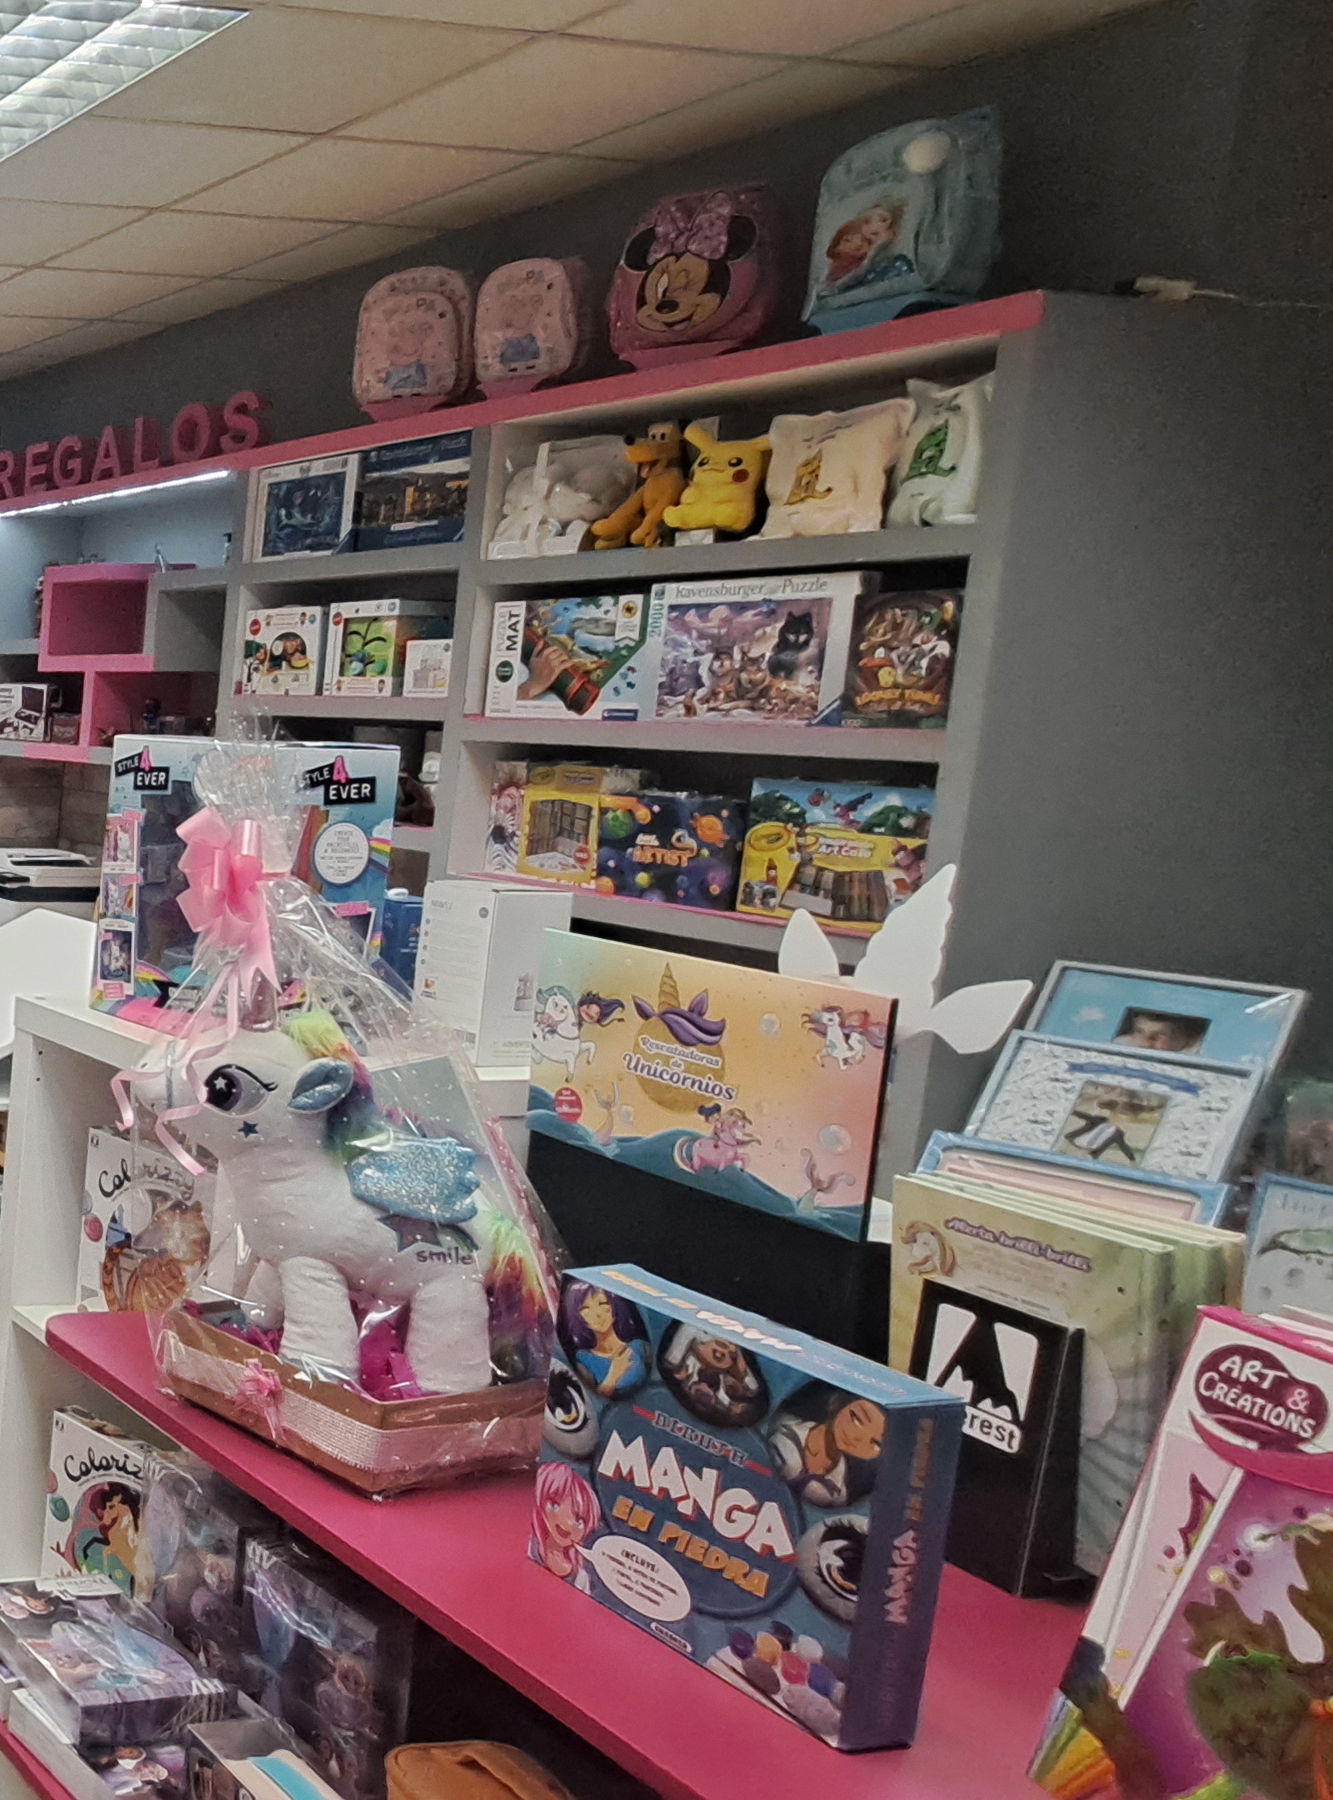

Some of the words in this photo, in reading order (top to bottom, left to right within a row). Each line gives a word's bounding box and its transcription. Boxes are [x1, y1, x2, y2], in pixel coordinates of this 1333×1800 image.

[675, 582, 766, 599] Ravensburger
[782, 578, 829, 593] Puzzle
[506, 610, 521, 651] MAT
[649, 603, 666, 638] 2000
[117, 755, 139, 773] STYLE
[139, 745, 151, 772] 4
[332, 755, 347, 783] 4
[136, 771, 167, 786] EVER
[328, 783, 372, 801] EVER
[640, 1036, 721, 1067] Rescatadoras
[622, 1053, 736, 1100] Unicornios
[416, 1247, 474, 1267] smile
[1218, 1354, 1287, 1387] ART
[1286, 1388, 1309, 1412] &
[966, 1409, 1018, 1451] rest
[598, 1429, 796, 1558] MANGA
[611, 1495, 655, 1532] EN
[657, 1520, 770, 1599] PIEDRA
[883, 1528, 917, 1624] MANGA
